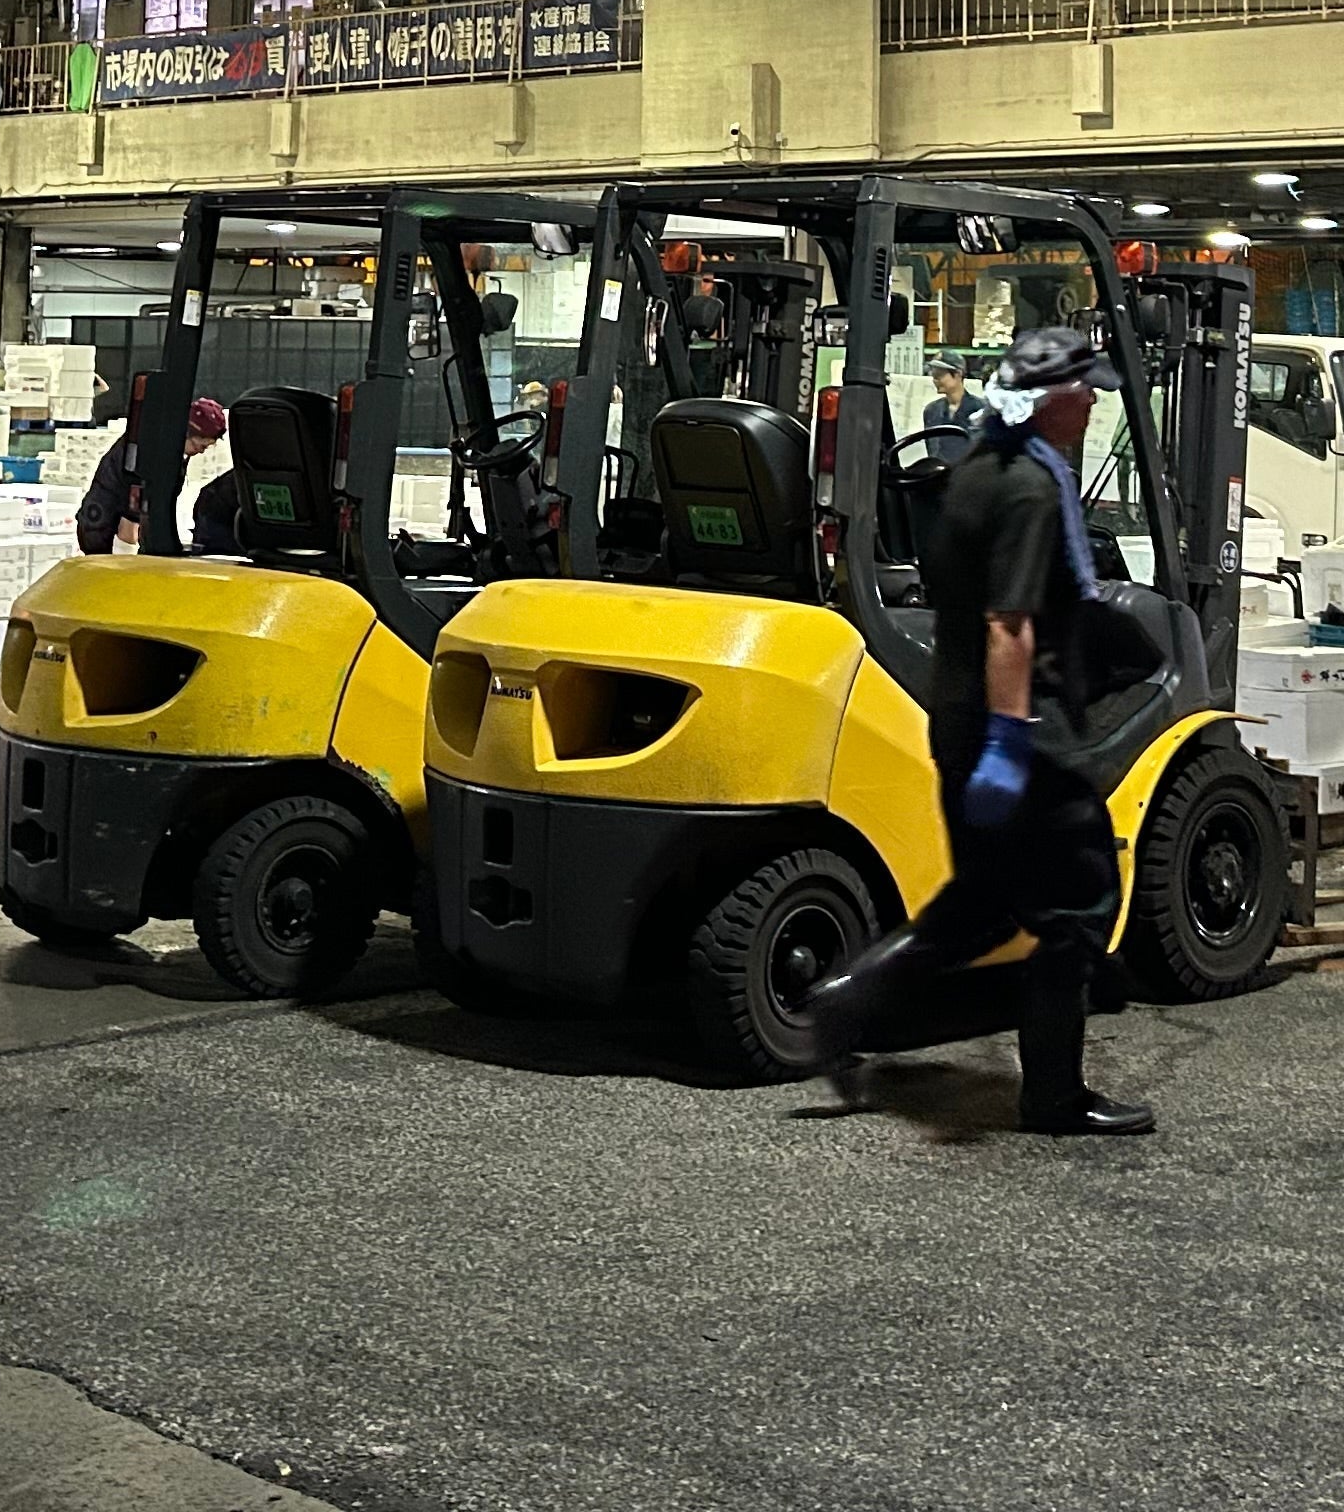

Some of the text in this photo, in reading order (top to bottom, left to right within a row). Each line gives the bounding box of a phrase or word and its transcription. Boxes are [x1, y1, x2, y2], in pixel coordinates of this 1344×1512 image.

[530, 4, 591, 29] 水産市場
[797, 296, 818, 414] KOMATSU
[1233, 302, 1251, 429] KOMATSU
